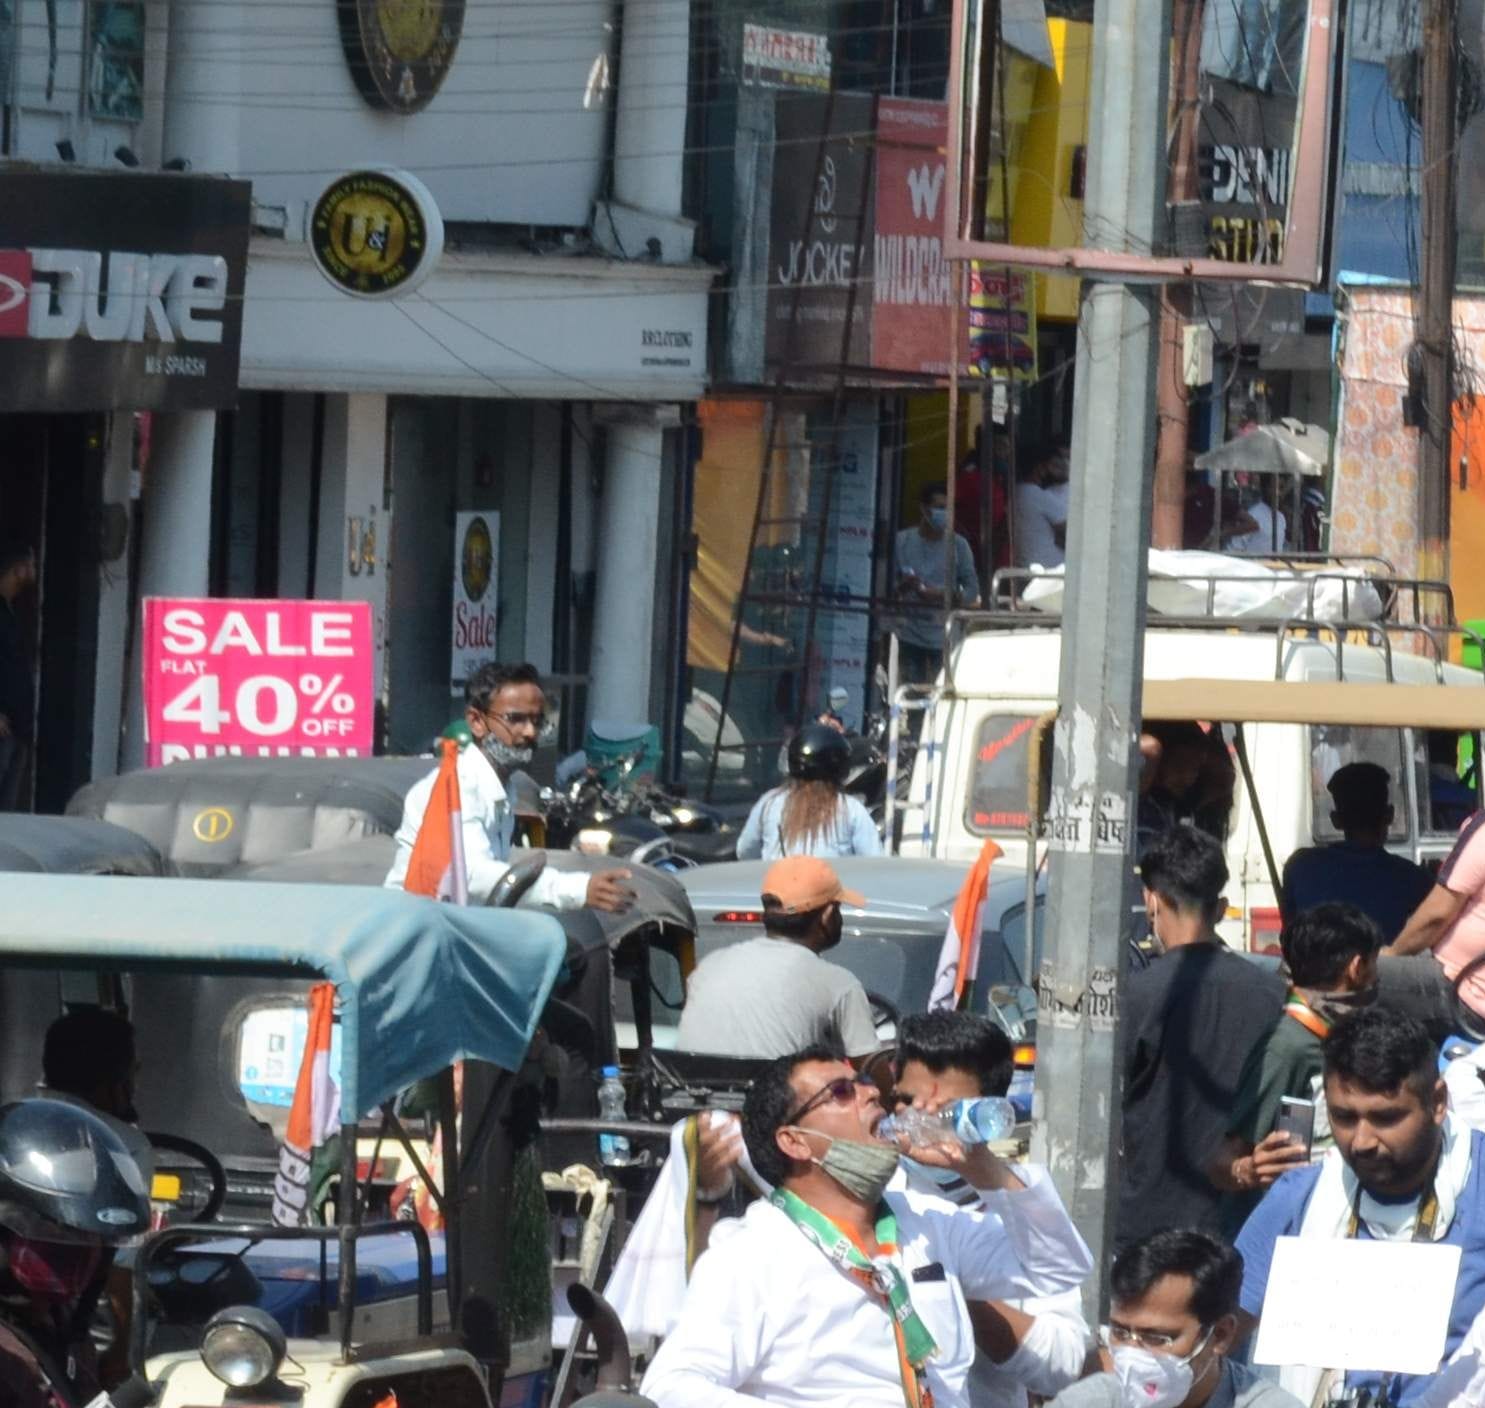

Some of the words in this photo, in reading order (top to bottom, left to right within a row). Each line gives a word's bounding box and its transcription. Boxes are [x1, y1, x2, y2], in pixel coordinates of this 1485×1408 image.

[1211, 145, 1291, 204] DENI
[165, 356, 206, 378] SPARSH
[161, 608, 355, 657] SALE
[455, 601, 497, 651] Sale
[160, 658, 206, 676] FLAT
[161, 673, 356, 737] 40%
[300, 718, 355, 738] OFF
